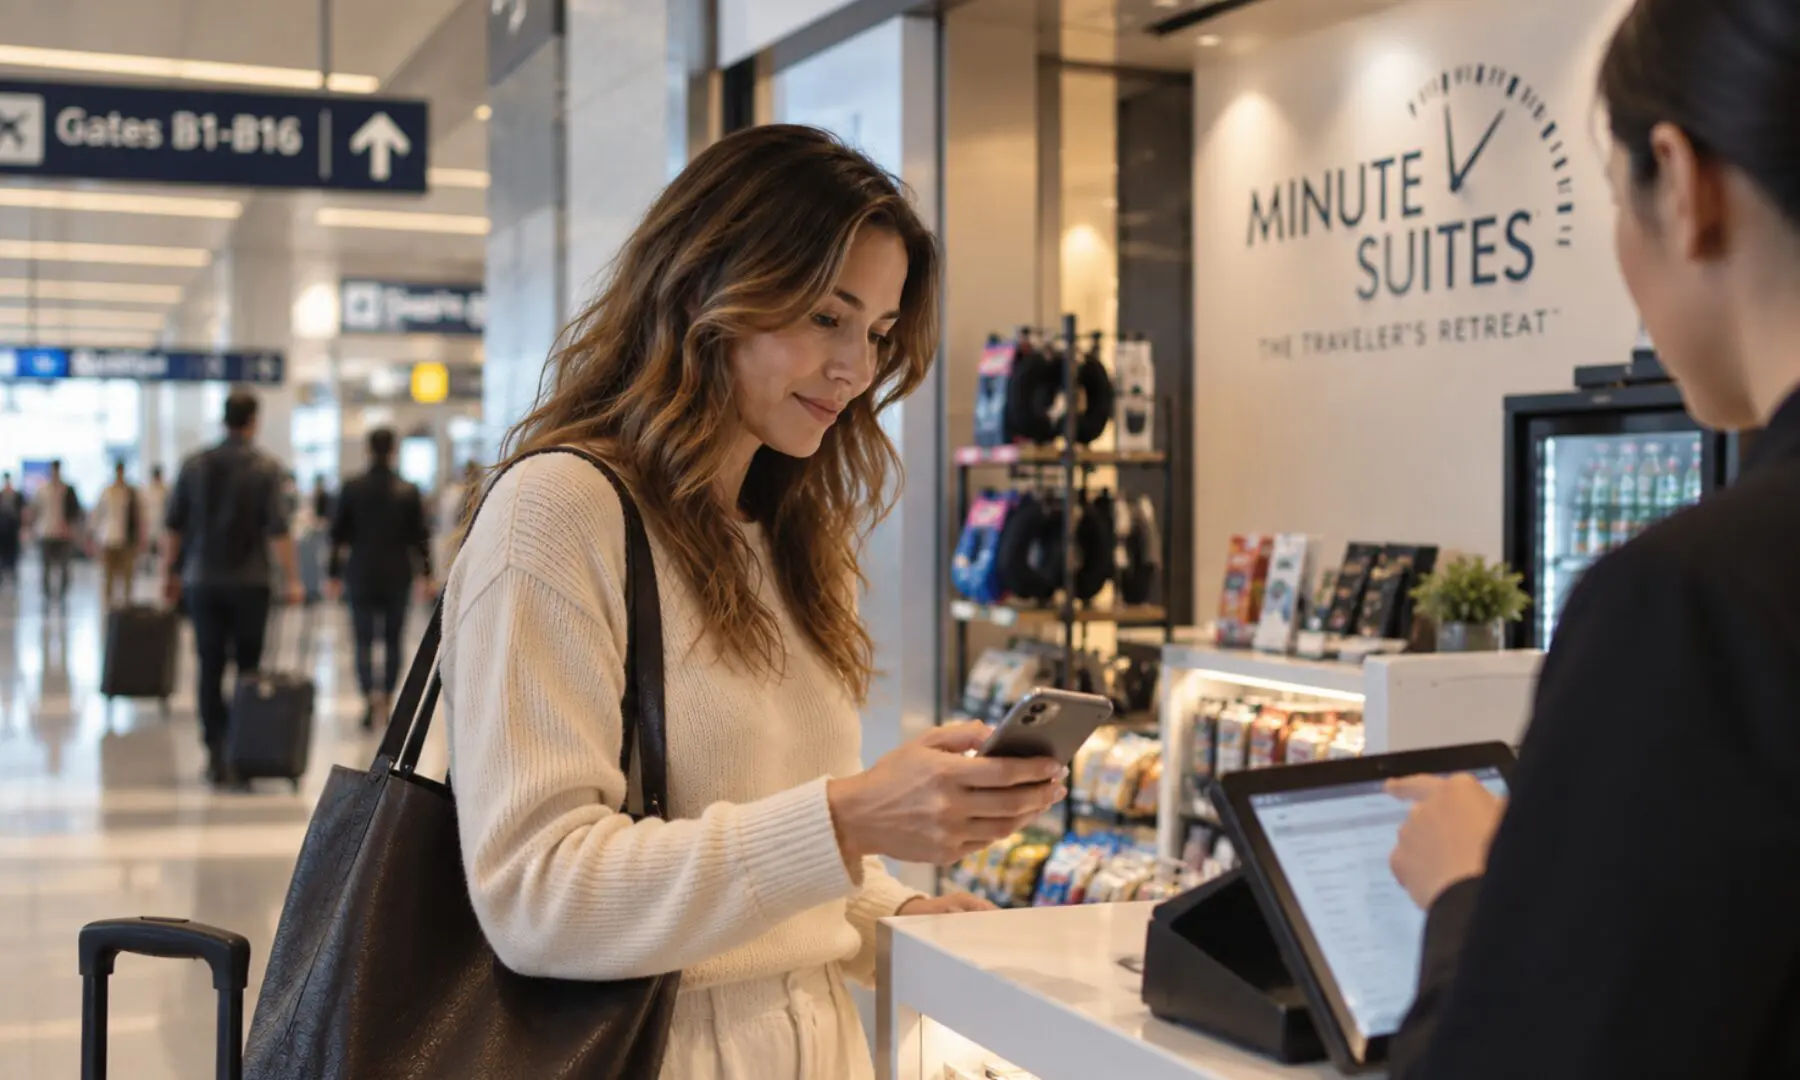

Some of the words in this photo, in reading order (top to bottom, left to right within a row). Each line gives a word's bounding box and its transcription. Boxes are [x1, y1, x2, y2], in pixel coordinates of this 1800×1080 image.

[55, 106, 164, 150] Gates
[171, 110, 303, 156] B1-B16
[1246, 150, 1424, 248] MINUTE
[1355, 209, 1535, 301] SUITES
[1258, 335, 1292, 360] THE
[1302, 320, 1427, 356] TRAVELER'S
